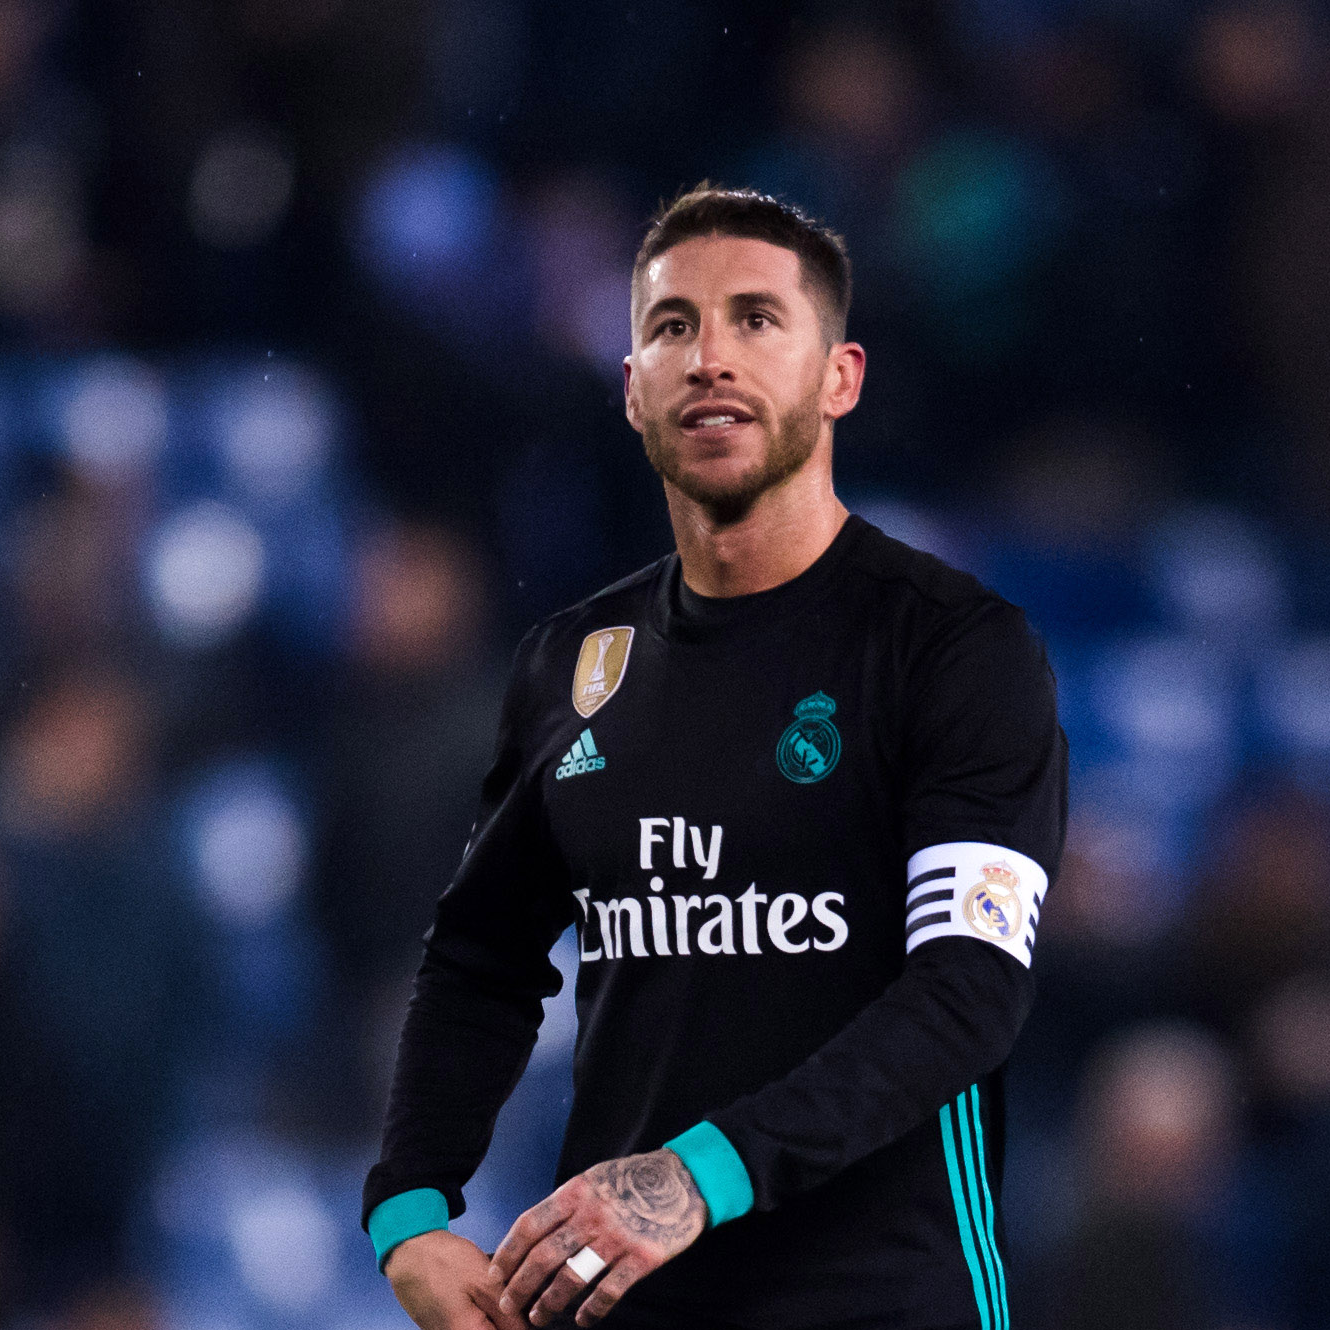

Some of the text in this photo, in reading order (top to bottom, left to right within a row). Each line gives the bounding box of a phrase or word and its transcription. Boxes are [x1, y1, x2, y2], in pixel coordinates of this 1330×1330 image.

[582, 681, 606, 696] FIFA
[555, 756, 606, 781] adidas
[639, 816, 723, 880] Fly
